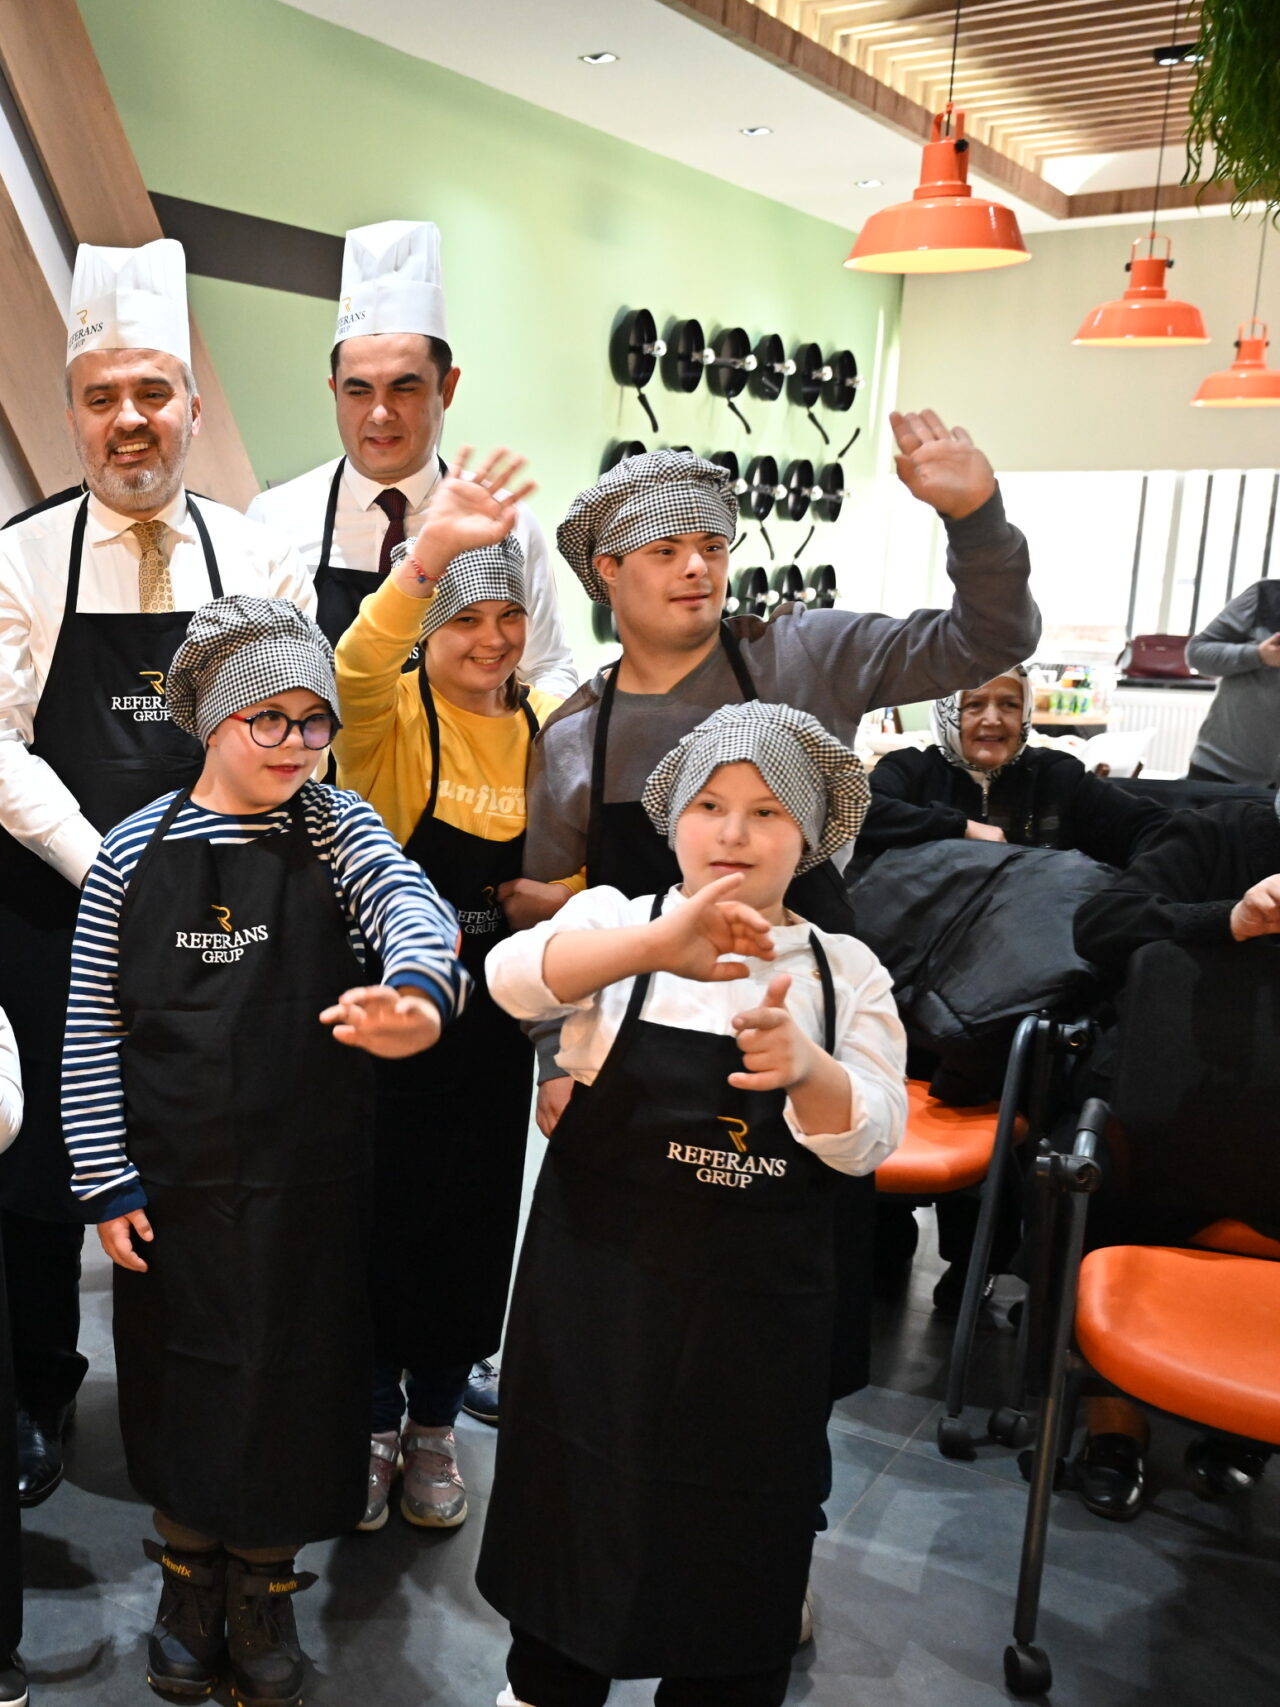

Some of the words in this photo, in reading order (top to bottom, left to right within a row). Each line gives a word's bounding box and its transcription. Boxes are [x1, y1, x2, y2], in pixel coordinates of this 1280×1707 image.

[133, 710, 172, 722] GRUP
[464, 921, 498, 935] GRUP
[175, 925, 269, 949] REFERANS
[202, 948, 244, 963] GRUP
[667, 1141, 787, 1177] REFERANS
[696, 1168, 753, 1188] GRUP
